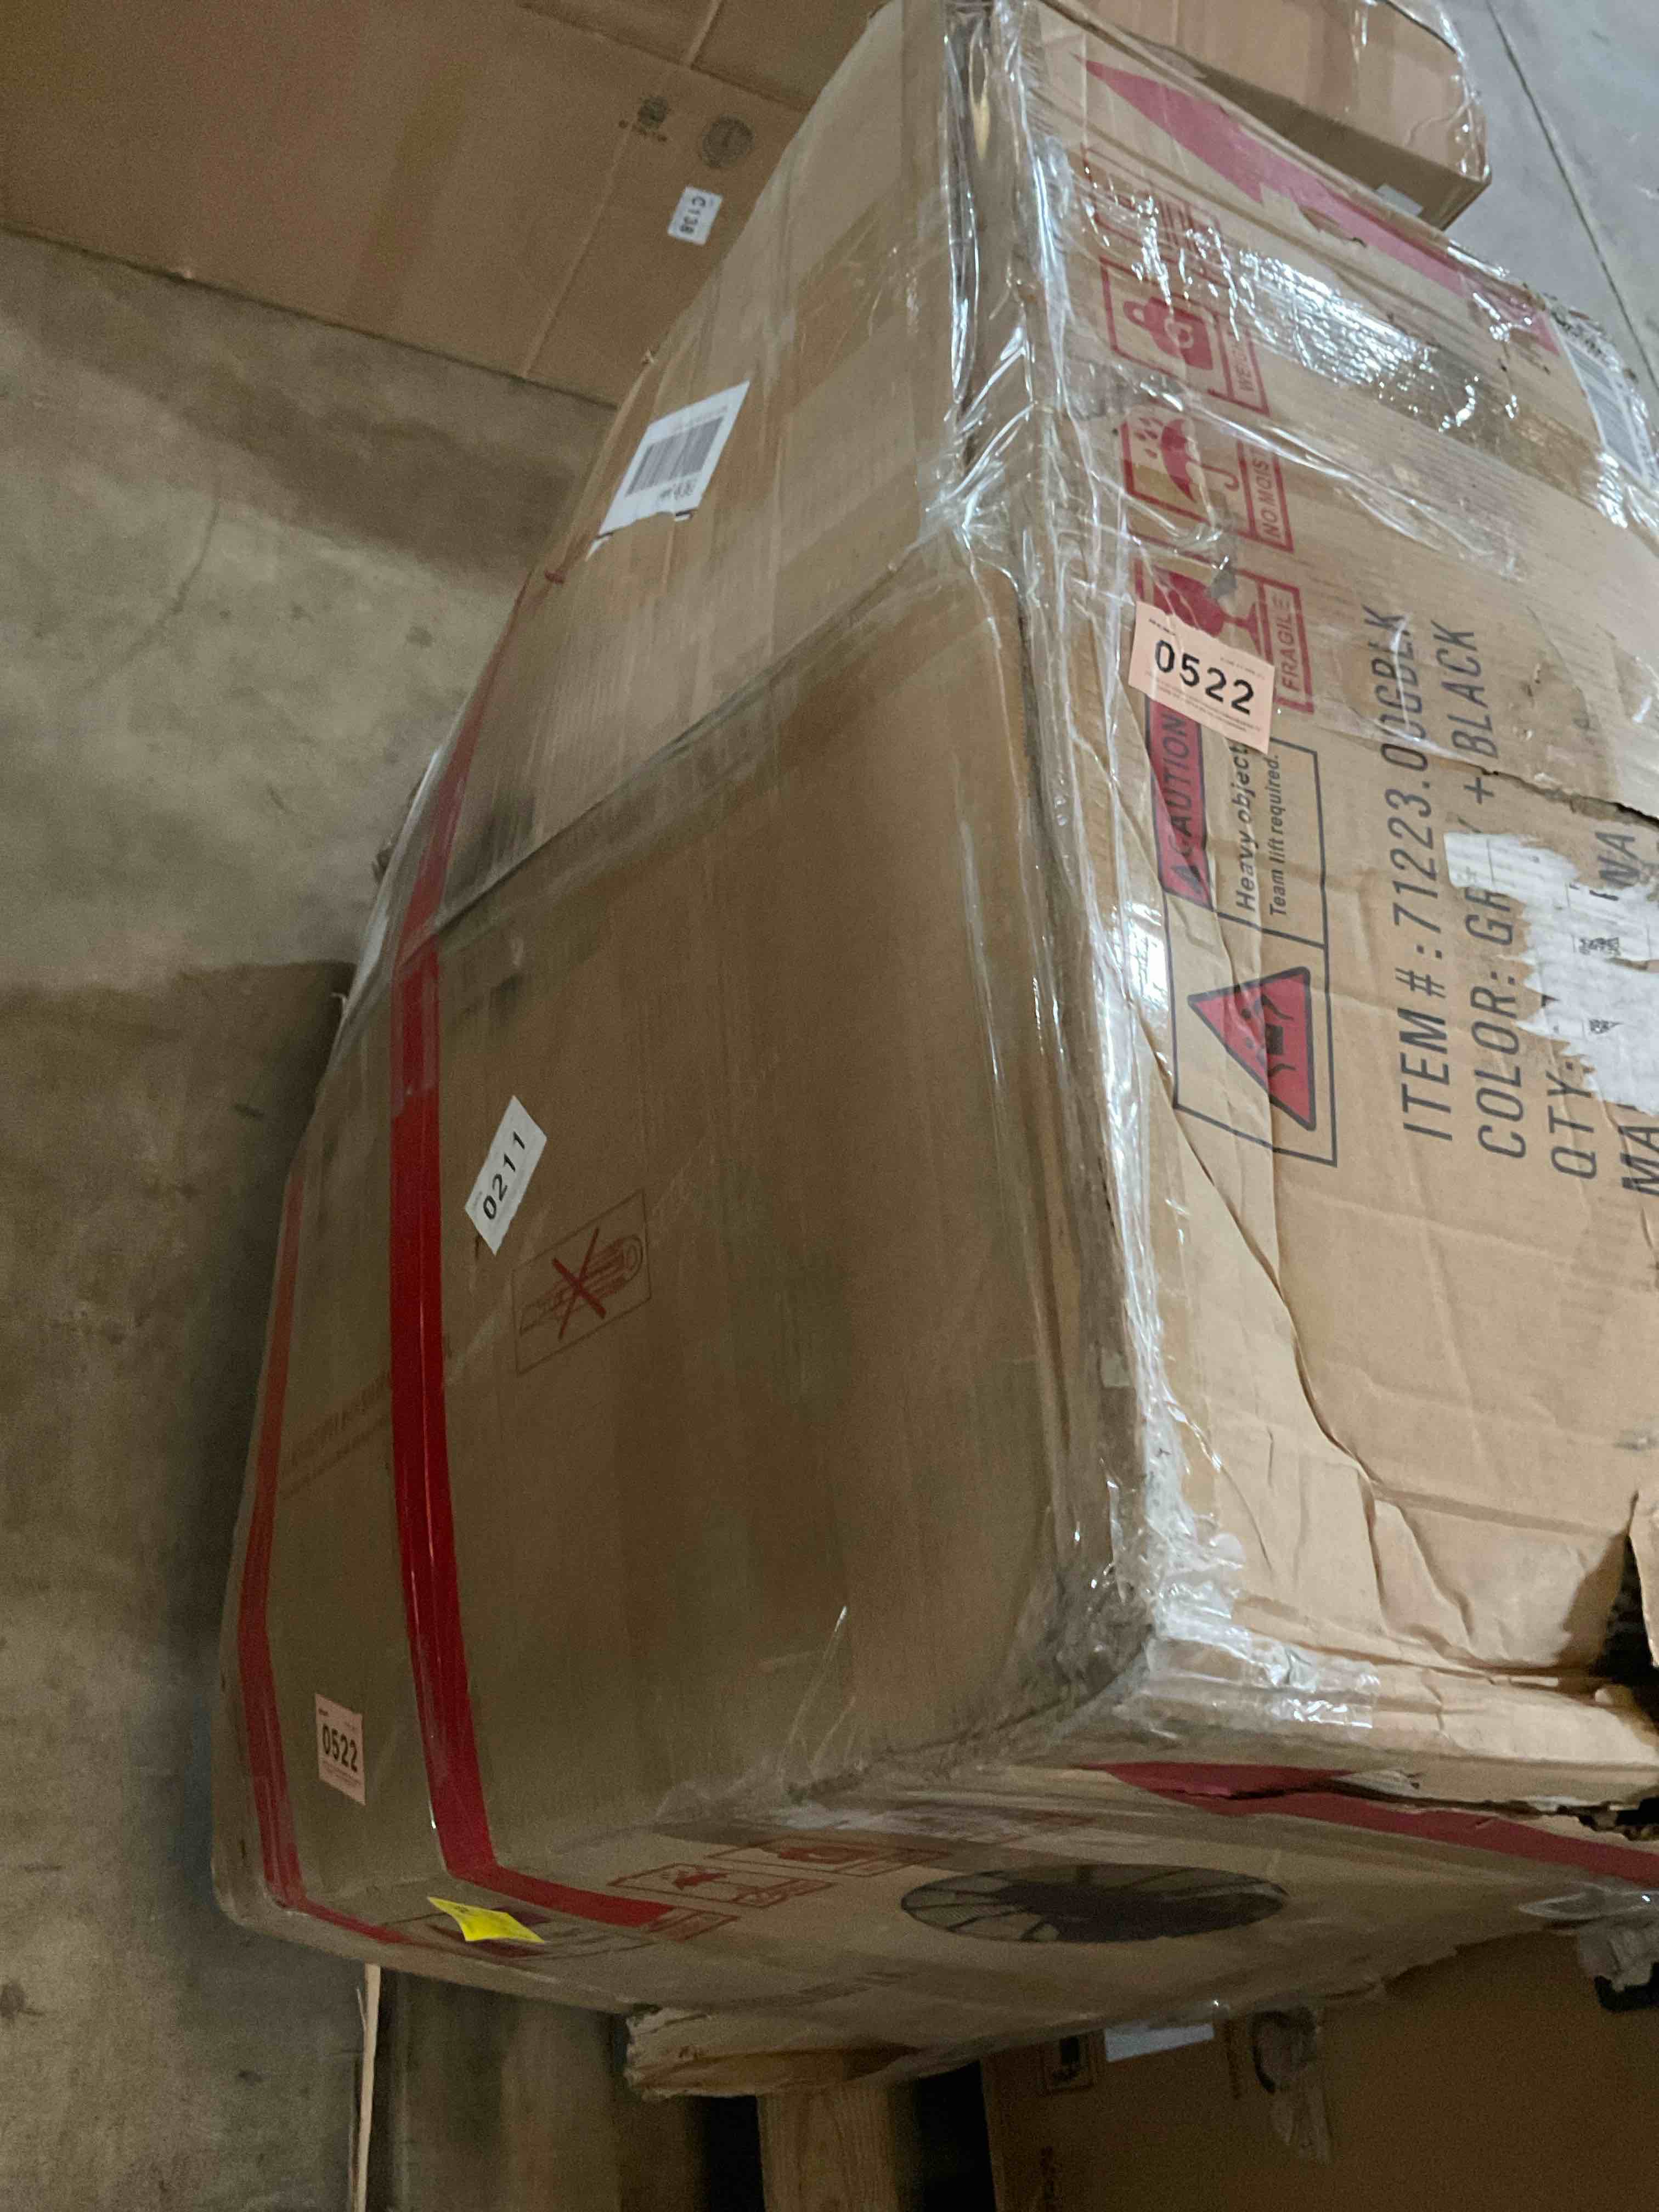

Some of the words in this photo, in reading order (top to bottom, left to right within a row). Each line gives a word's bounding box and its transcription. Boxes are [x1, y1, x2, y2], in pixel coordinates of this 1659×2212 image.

[1261, 509, 1281, 539] NO
[1154, 639, 1254, 715] 0522
[1272, 596, 1303, 691] FRAGILE
[1430, 619, 1499, 760] BLACK
[1160, 714, 1194, 859] CAUTION
[1229, 744, 1256, 823] object
[1262, 754, 1286, 836] required.
[1464, 777, 1495, 804] +
[1235, 830, 1259, 913] Heavy
[1268, 835, 1286, 864] lift
[1269, 868, 1287, 917] Team
[1397, 1007, 1453, 1142] ITEM
[1470, 971, 1527, 1159] COLOR:
[483, 1130, 526, 1220] 0211
[322, 1723, 358, 1773] 0522
